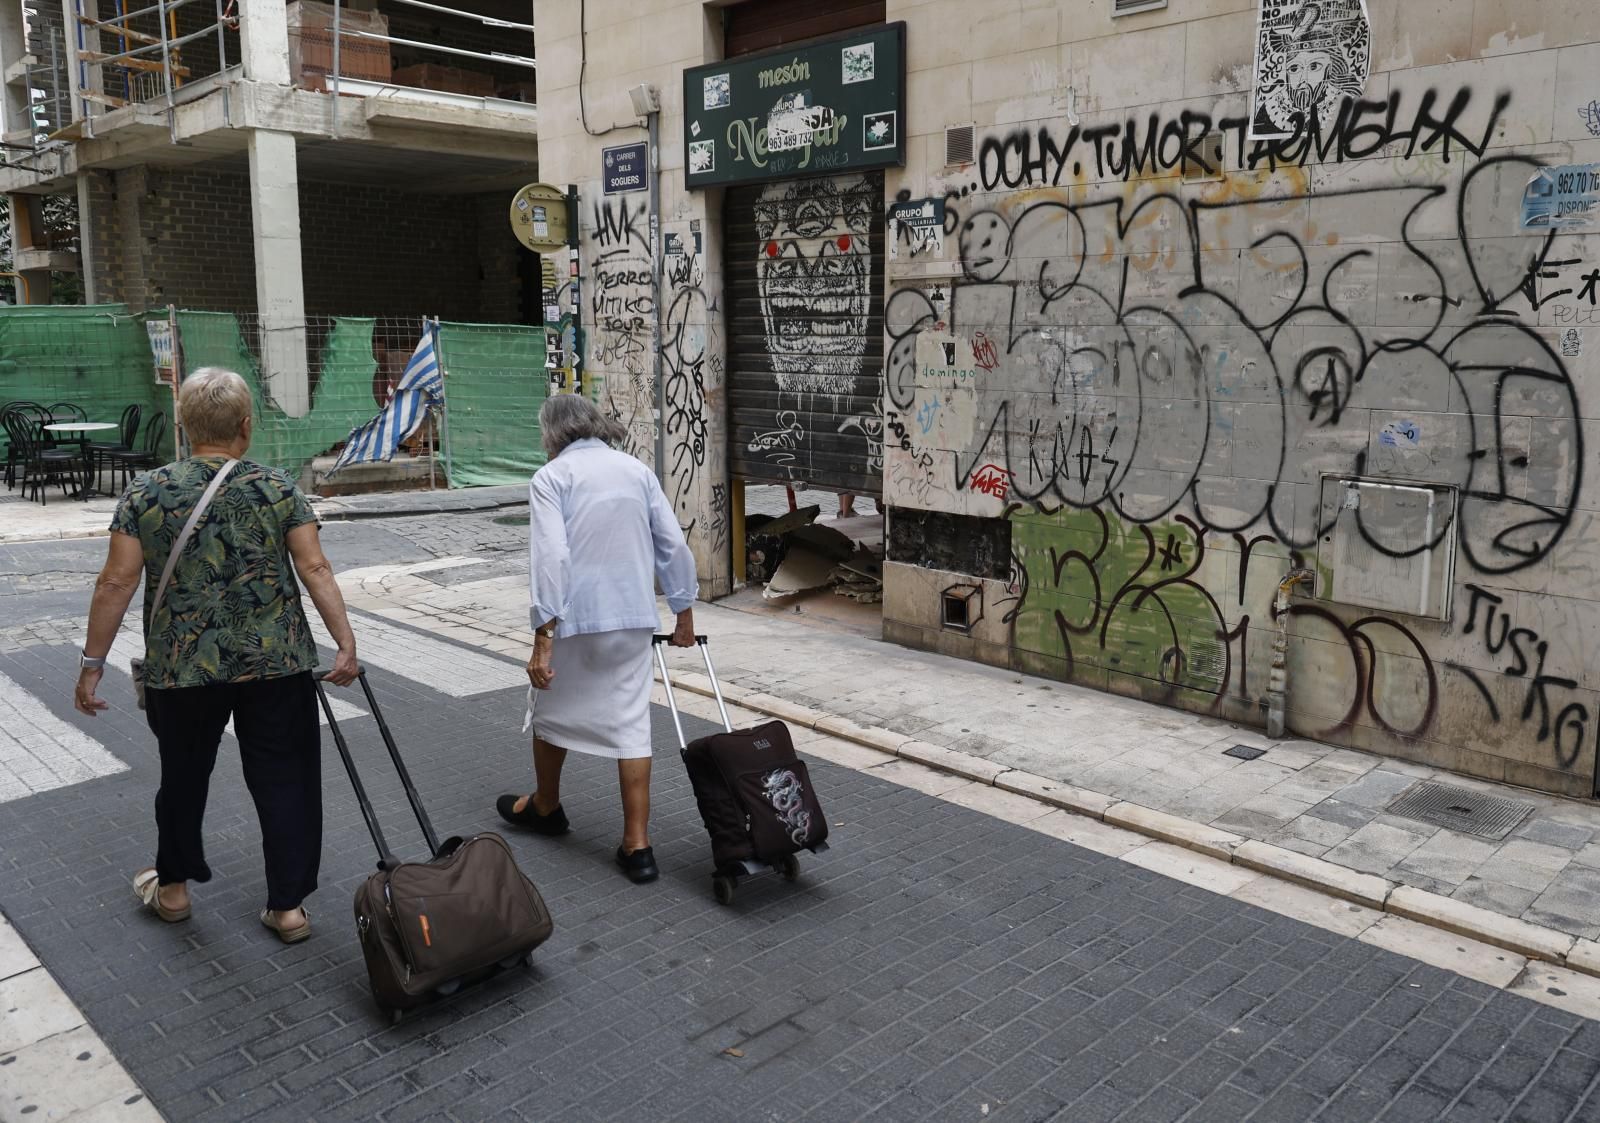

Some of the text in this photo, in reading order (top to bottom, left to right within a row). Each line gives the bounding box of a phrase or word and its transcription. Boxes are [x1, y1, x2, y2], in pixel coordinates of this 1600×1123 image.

[1262, 8, 1281, 20] NO
[758, 57, 811, 89] mesón
[768, 137, 782, 150] 963
[784, 134, 797, 147] 489
[616, 151, 636, 161] CARRER
[618, 164, 632, 172] DELS
[610, 175, 640, 187] SOGUERS
[1557, 173, 1574, 194] 962
[1576, 172, 1587, 193] 70
[895, 208, 922, 218] GRUPO
[597, 270, 653, 290] PERRO
[922, 363, 977, 382] domingo
